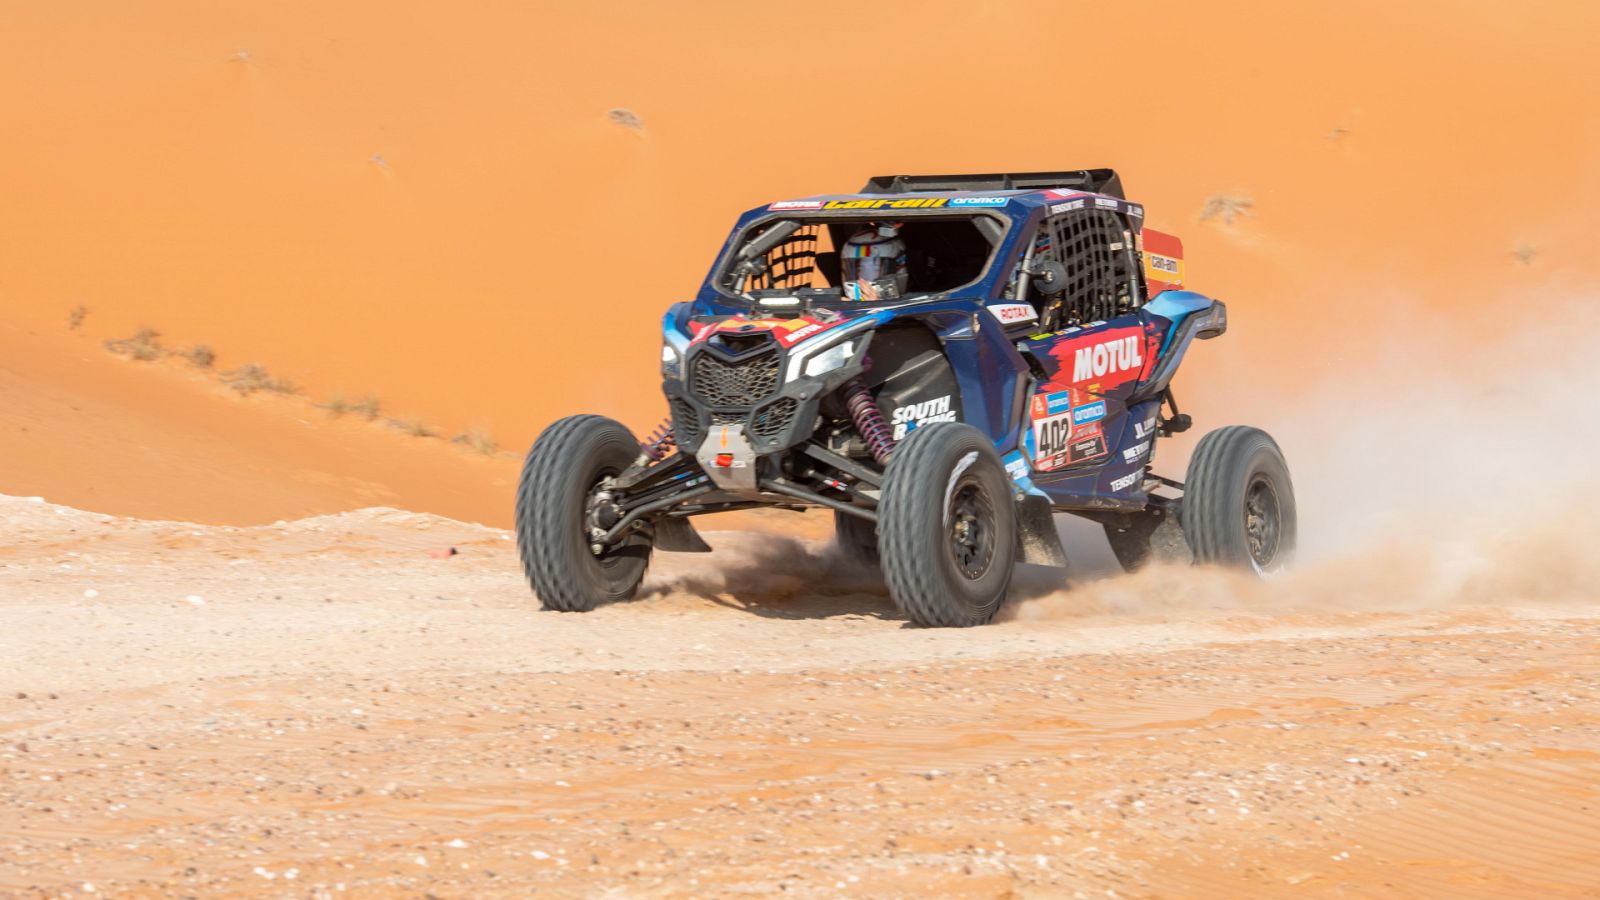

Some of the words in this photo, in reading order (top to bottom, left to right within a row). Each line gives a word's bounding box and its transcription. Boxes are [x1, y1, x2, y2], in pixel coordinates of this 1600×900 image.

[953, 197, 1005, 206] aramco
[1151, 255, 1178, 273] can-am
[1000, 308, 1029, 320] ROTAX
[784, 324, 823, 342] MOTUL
[1072, 335, 1142, 383] MOTUL
[891, 395, 951, 424] SOUTH
[1074, 405, 1103, 421] aramco
[1040, 418, 1069, 458] 402
